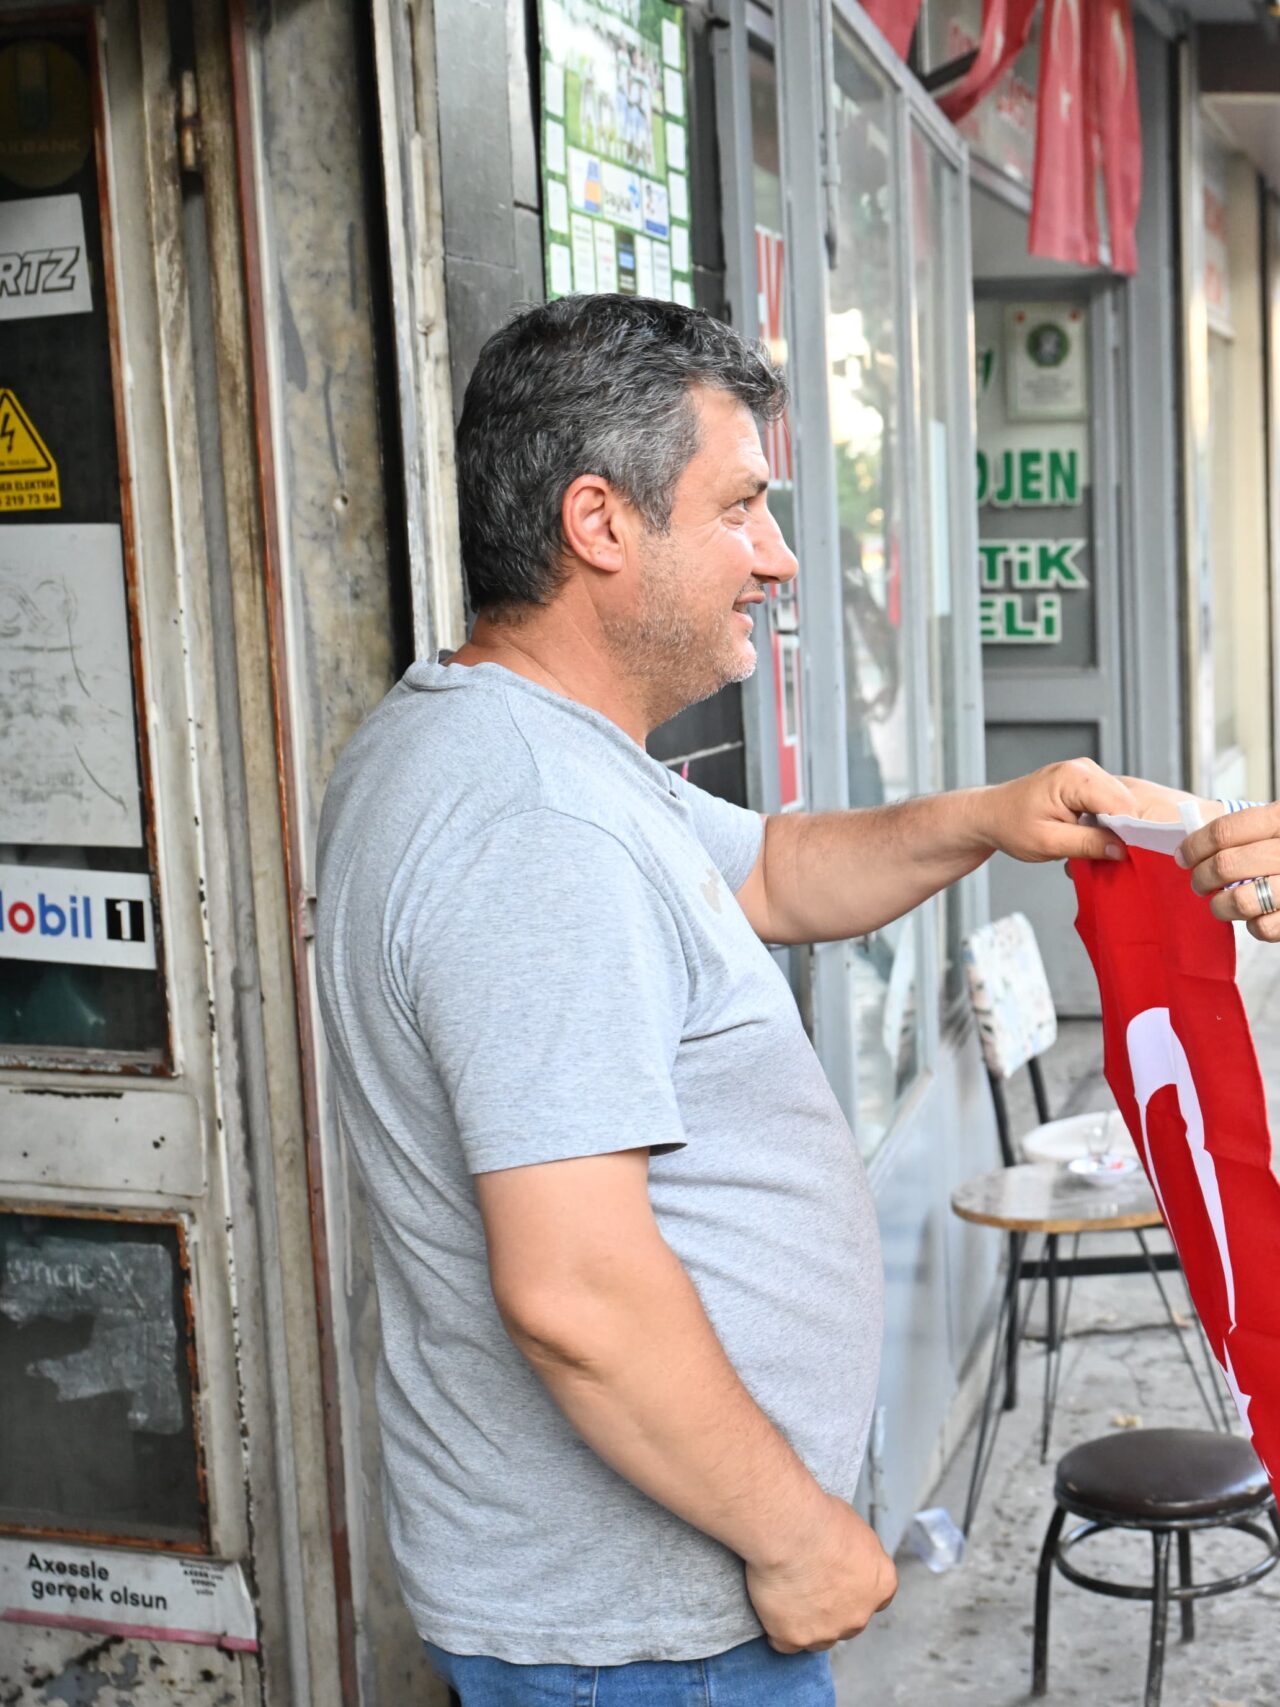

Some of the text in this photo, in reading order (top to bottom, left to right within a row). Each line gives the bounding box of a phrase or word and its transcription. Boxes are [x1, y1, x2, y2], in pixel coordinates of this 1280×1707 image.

[27, 492, 40, 504] 73
[0, 890, 136, 941] obil 1
[27, 1552, 110, 1581] Axessle
[31, 1578, 168, 1611] gerçek olsun
